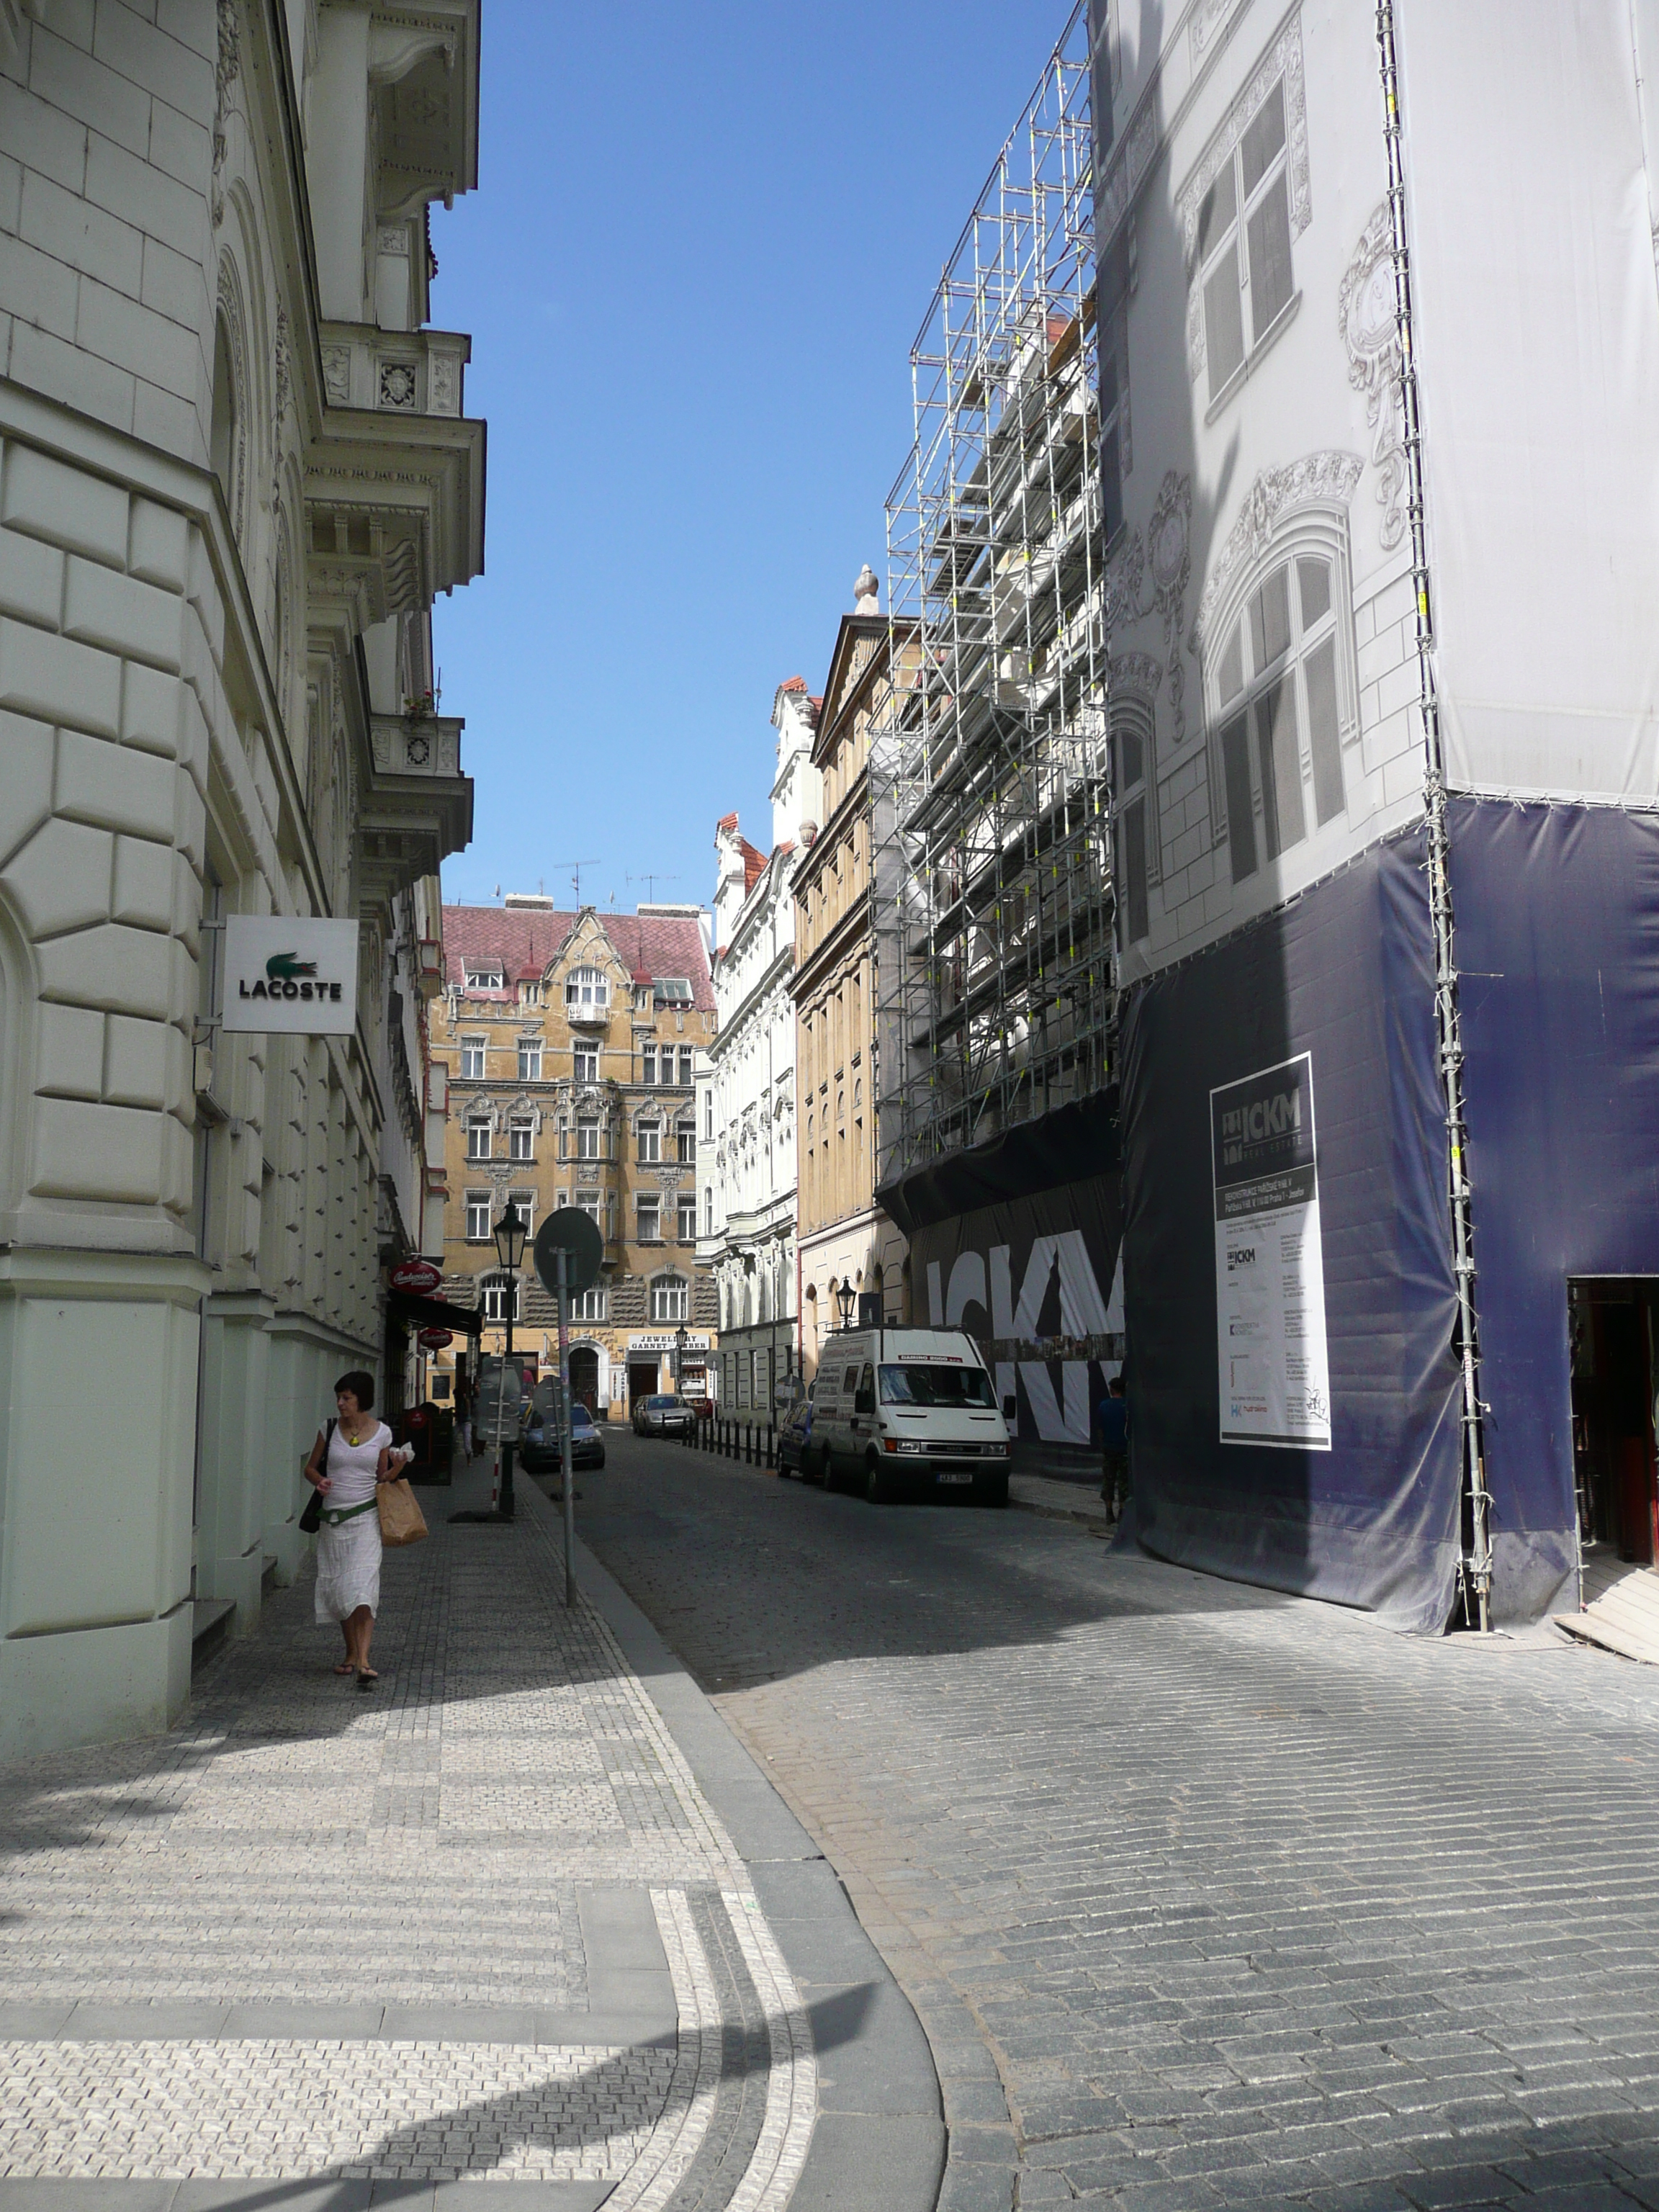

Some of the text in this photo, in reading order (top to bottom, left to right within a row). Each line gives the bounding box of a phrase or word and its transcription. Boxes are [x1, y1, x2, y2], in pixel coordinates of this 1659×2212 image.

[239, 979, 341, 999] LACOSTE
[1242, 1088, 1301, 1143] ICKM
[1269, 1134, 1303, 1154] ESTATE
[1235, 1248, 1256, 1264] ICKM
